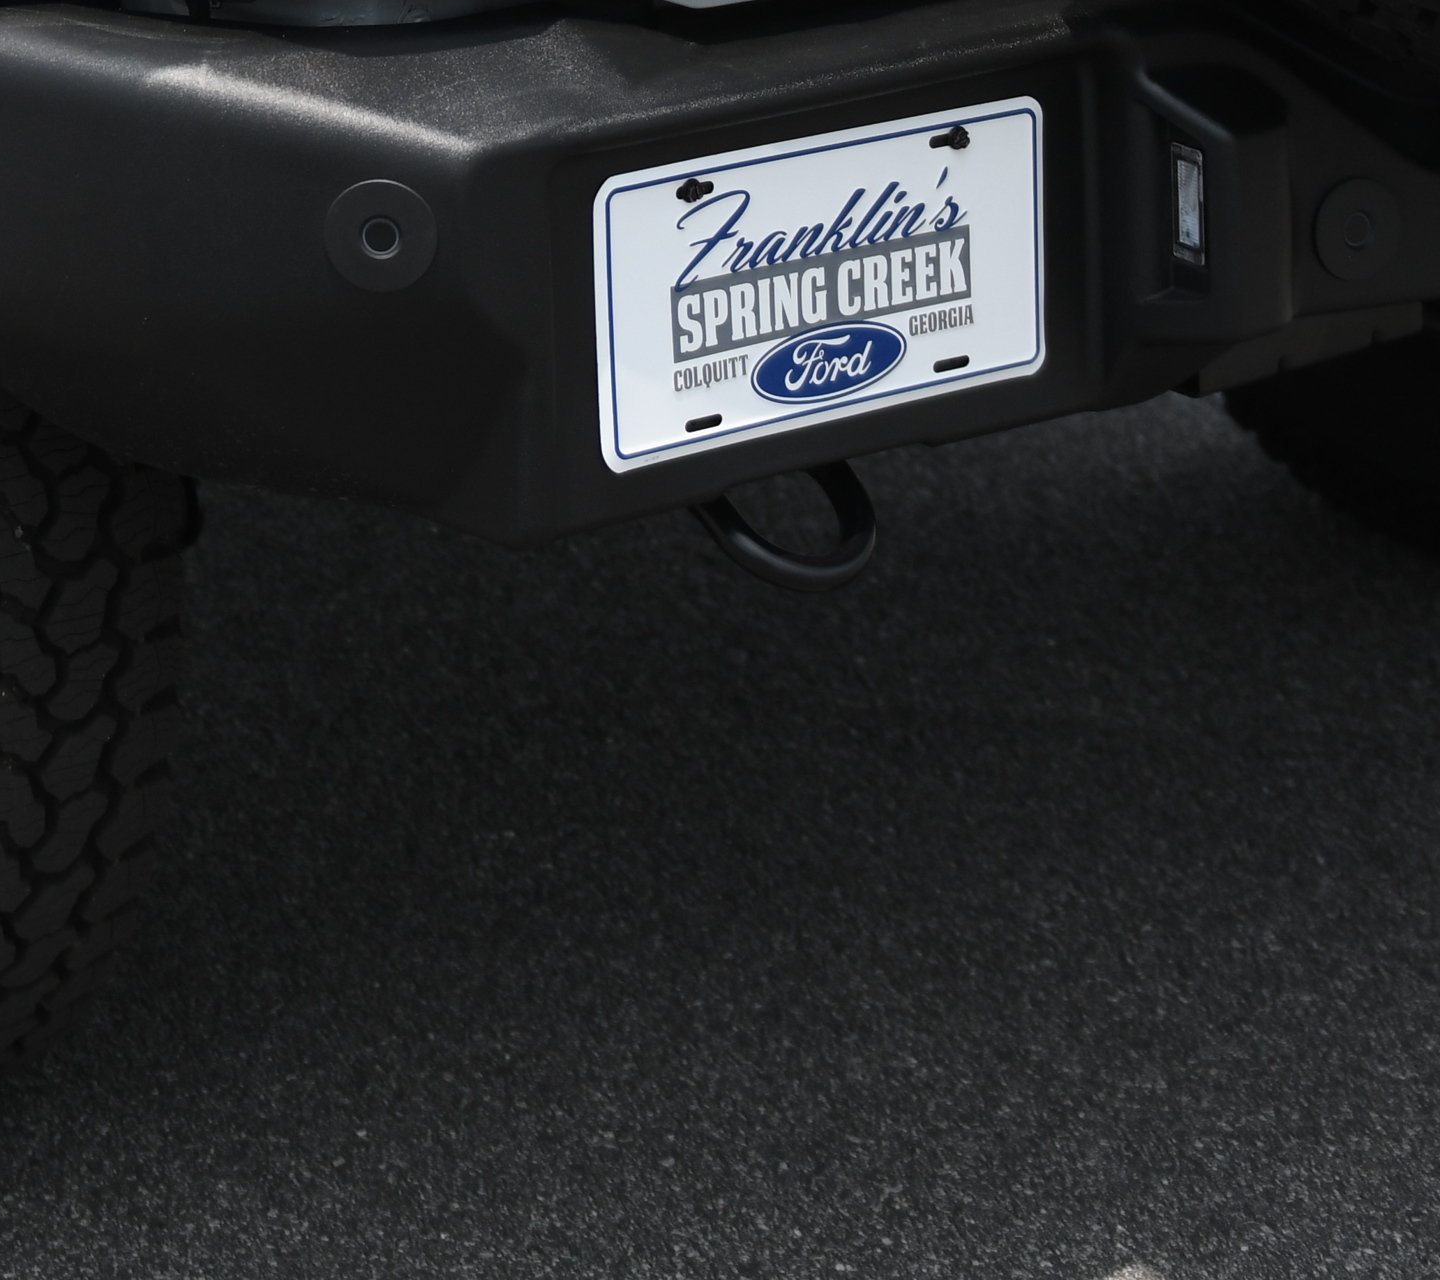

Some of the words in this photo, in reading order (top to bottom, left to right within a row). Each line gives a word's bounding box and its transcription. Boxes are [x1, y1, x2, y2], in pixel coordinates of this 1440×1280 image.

[673, 166, 969, 293] Franklin's
[677, 267, 828, 353] SPRING
[837, 237, 968, 316] CREEK
[908, 303, 975, 337] GEORGIA
[672, 354, 749, 393] COLQUITT
[783, 333, 875, 392] Ford
